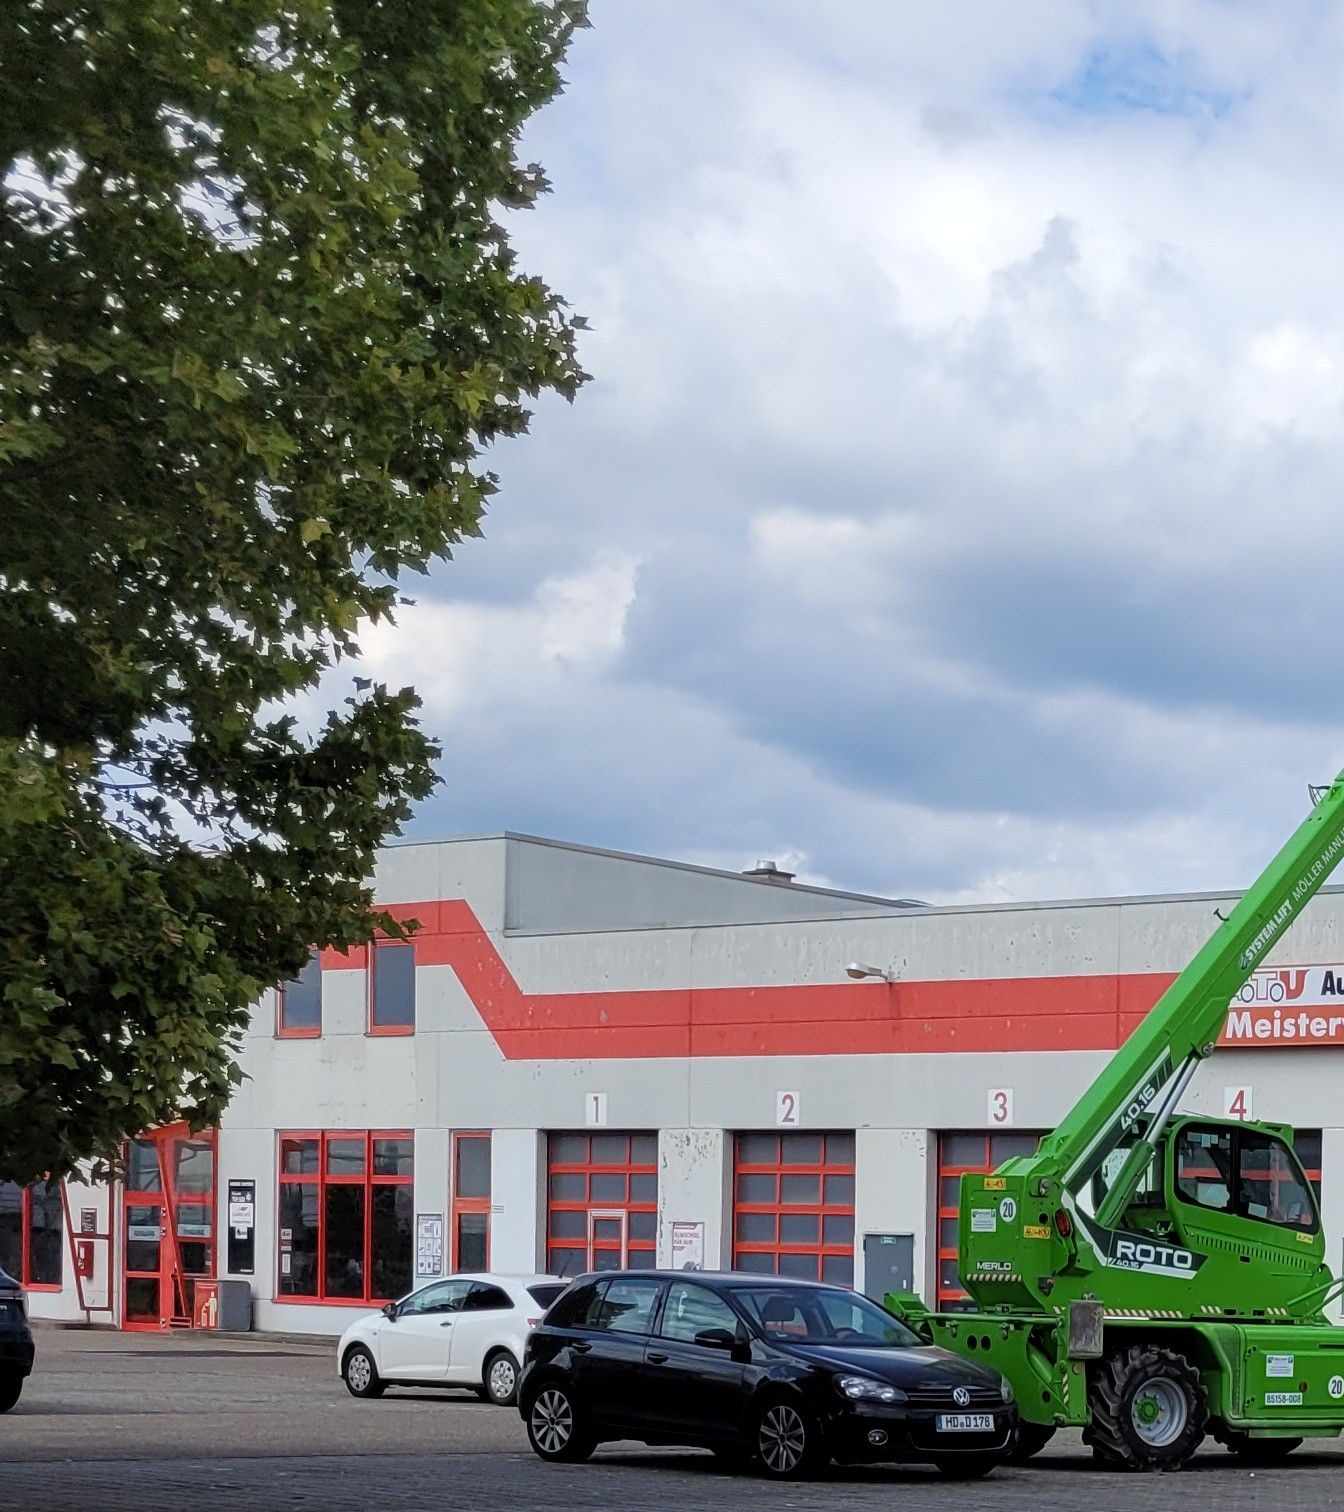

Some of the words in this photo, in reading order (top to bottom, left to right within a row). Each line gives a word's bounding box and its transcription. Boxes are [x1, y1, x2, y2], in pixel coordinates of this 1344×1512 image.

[592, 1096, 599, 1123] 1
[782, 1094, 795, 1122] 2
[993, 1092, 1007, 1122] 3
[1120, 1084, 1156, 1132] 40.16
[1228, 1090, 1247, 1121] 4
[1003, 1202, 1013, 1218] 20
[976, 1261, 1011, 1270] MERLO
[1117, 1240, 1192, 1269] ROTO
[1331, 1380, 1342, 1394] 20
